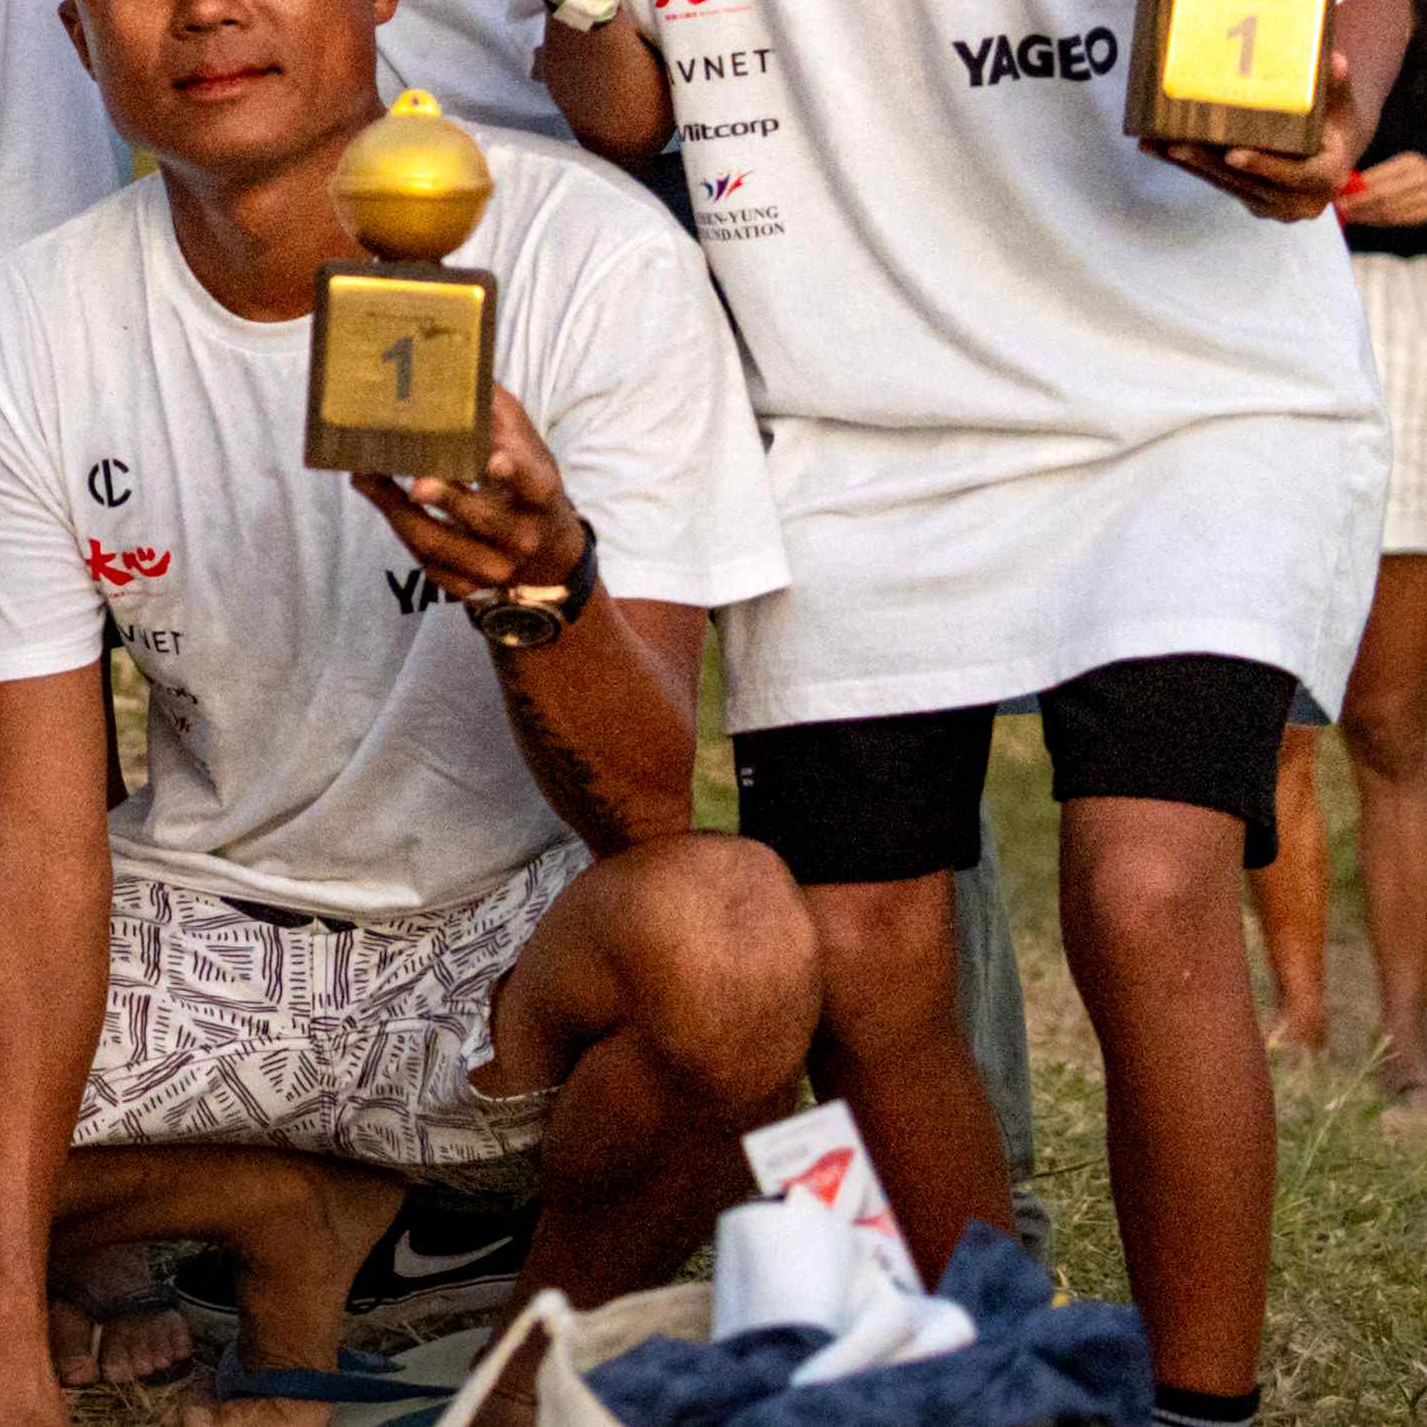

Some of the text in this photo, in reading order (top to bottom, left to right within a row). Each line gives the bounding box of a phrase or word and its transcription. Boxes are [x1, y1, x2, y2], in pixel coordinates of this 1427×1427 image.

[953, 27, 1119, 88] YAGEO
[1227, 15, 1259, 78] 1
[381, 335, 413, 400] 1
